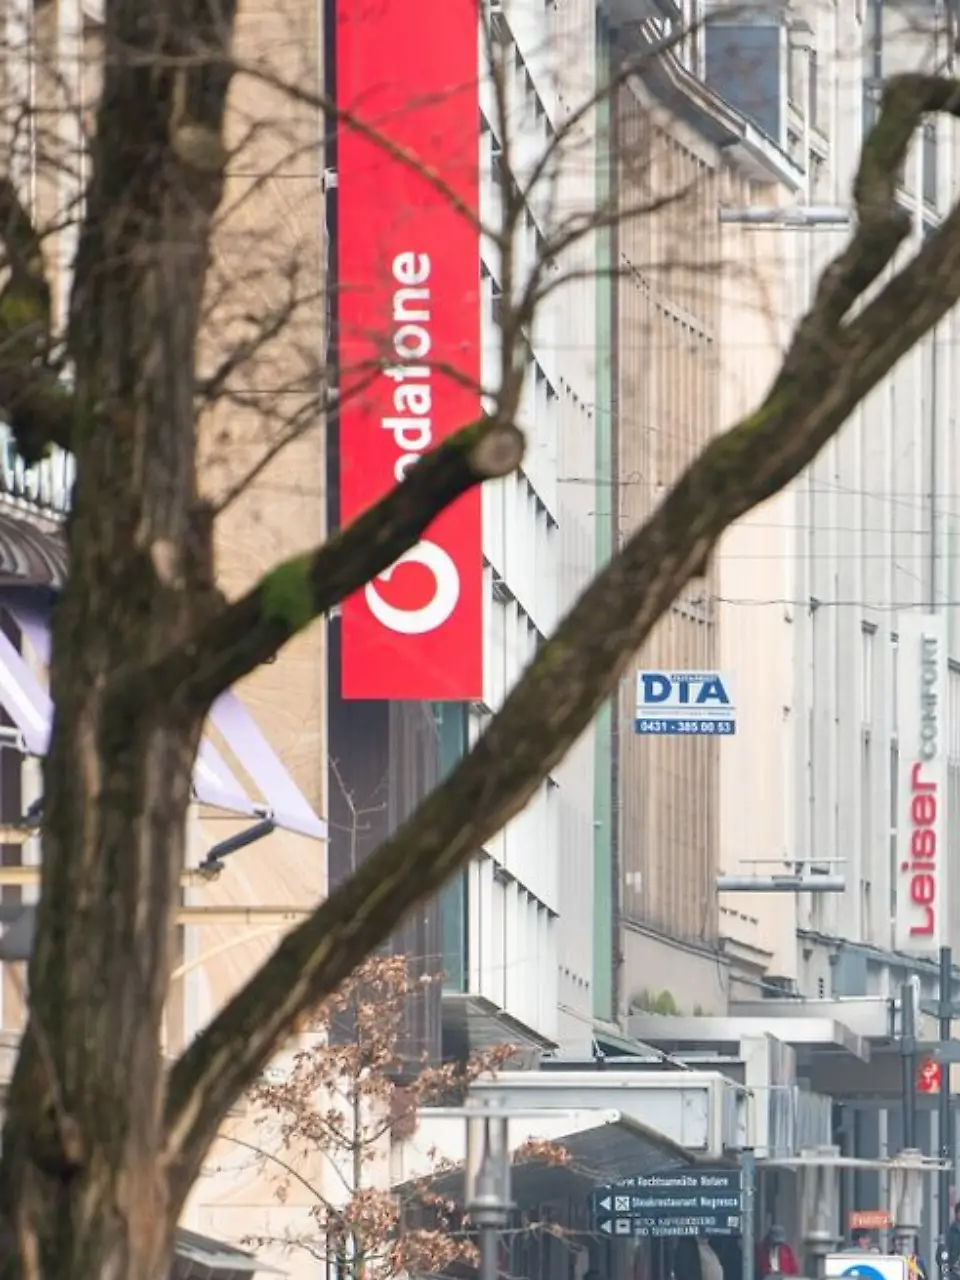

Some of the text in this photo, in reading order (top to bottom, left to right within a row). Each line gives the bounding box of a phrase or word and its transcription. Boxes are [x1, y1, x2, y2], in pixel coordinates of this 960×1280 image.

[382, 251, 432, 484] odafone
[641, 674, 730, 704] DTA
[641, 721, 667, 731] 0431
[901, 761, 938, 938] Leiser
